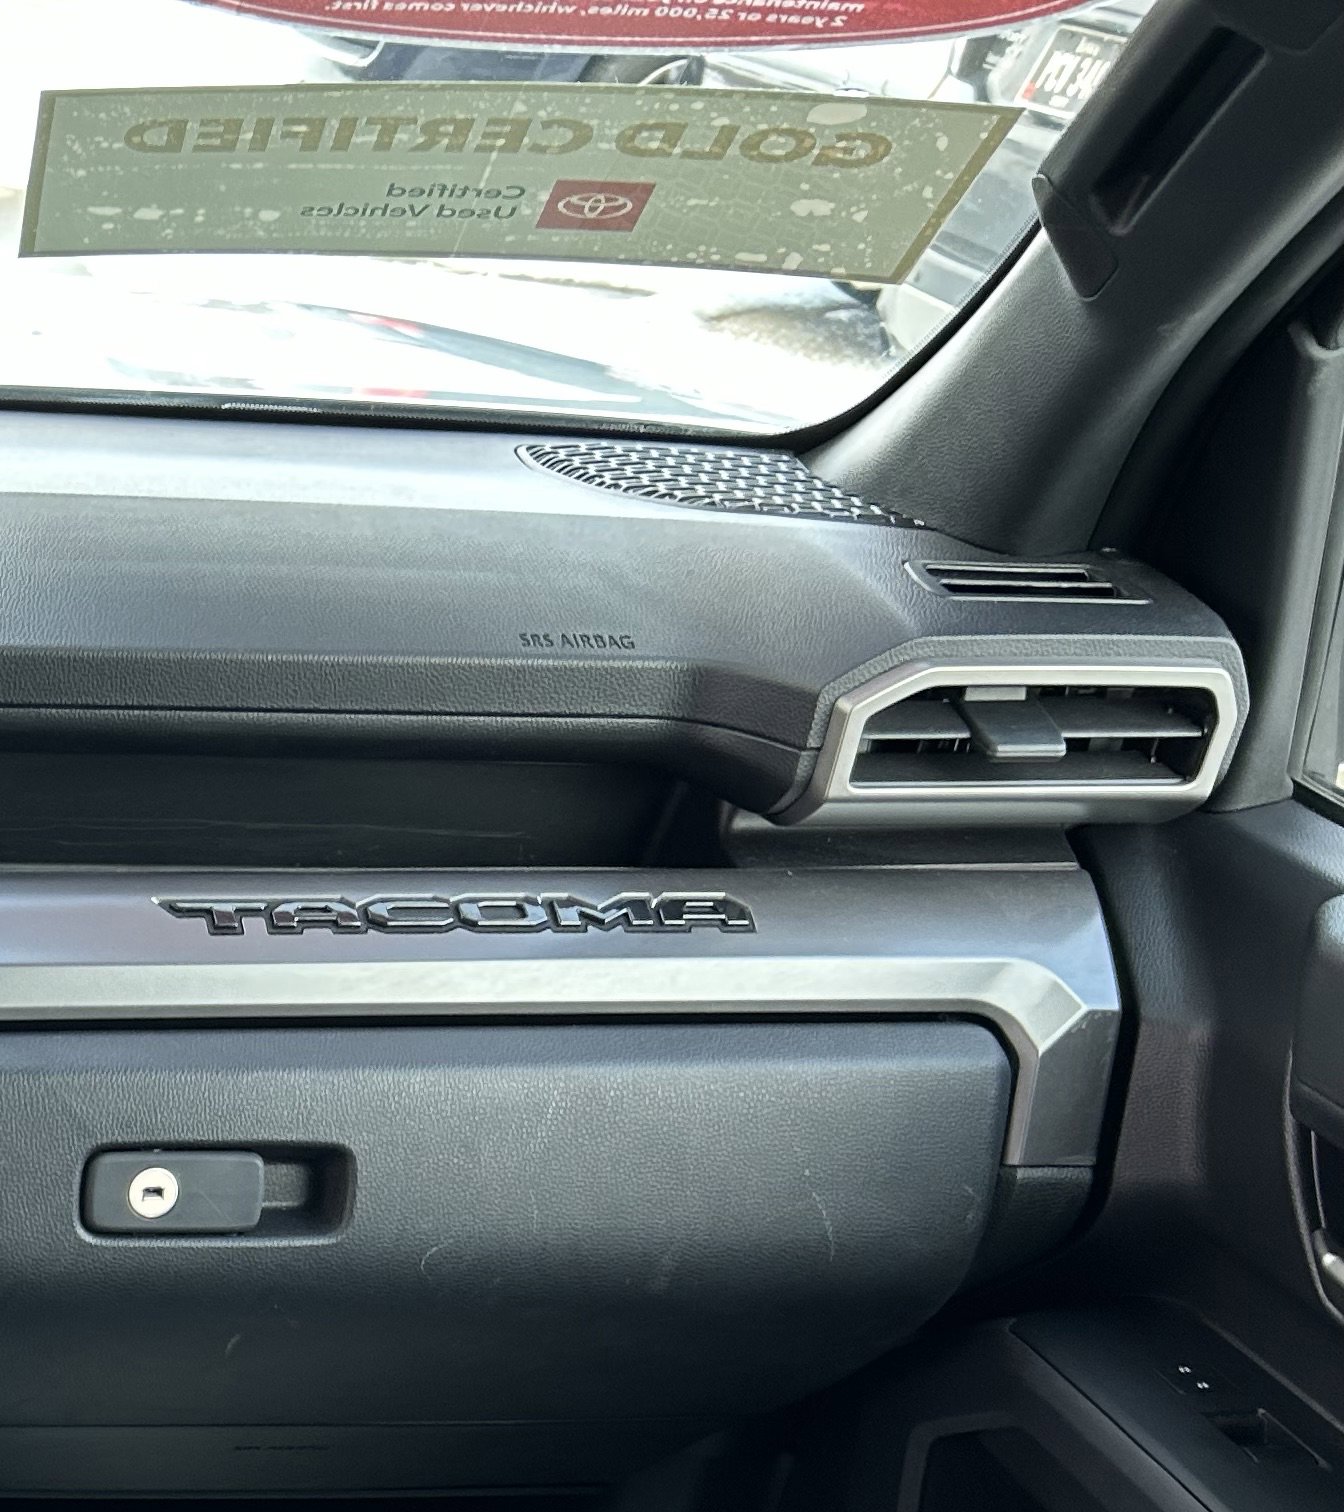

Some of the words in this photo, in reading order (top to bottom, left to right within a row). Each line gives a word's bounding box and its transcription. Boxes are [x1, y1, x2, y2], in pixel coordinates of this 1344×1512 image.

[519, 633, 554, 648] SRS
[559, 633, 636, 650] AIRBAG
[151, 891, 757, 935] TACOMA
